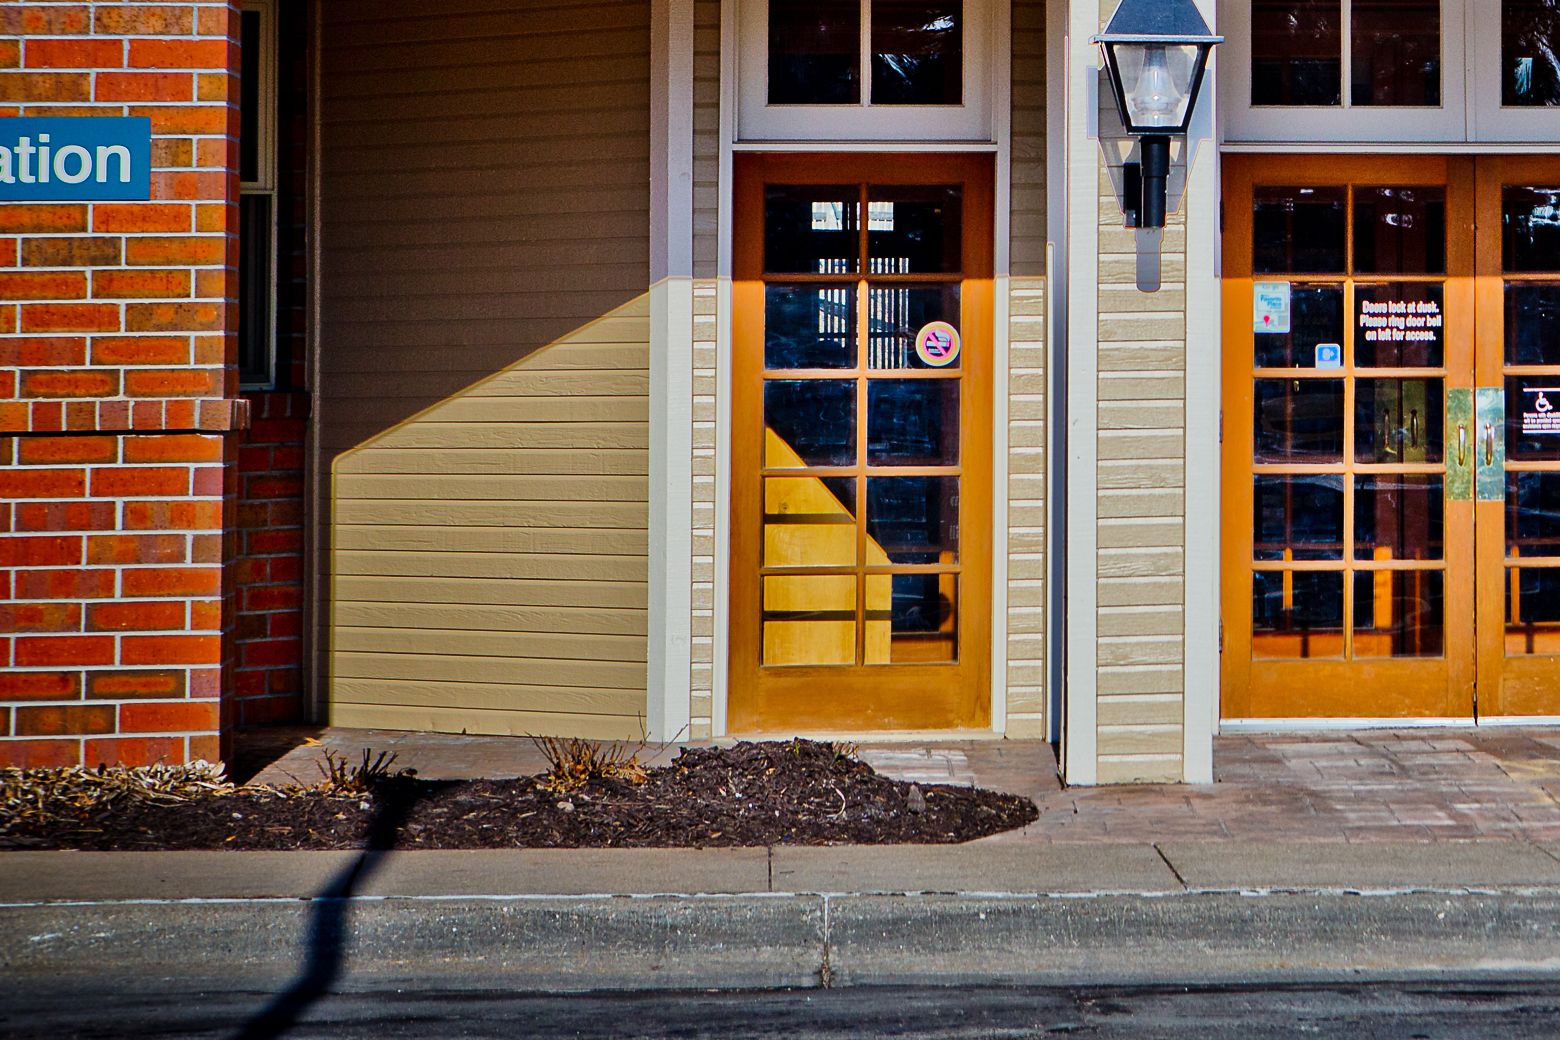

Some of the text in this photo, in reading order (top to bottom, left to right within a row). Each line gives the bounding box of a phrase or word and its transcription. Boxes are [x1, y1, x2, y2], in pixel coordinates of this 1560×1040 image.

[1362, 300, 1440, 313] Doors lock at dusk.
[1359, 314, 1442, 329] Please ring door bell
[1365, 328, 1437, 341] on left for access.
